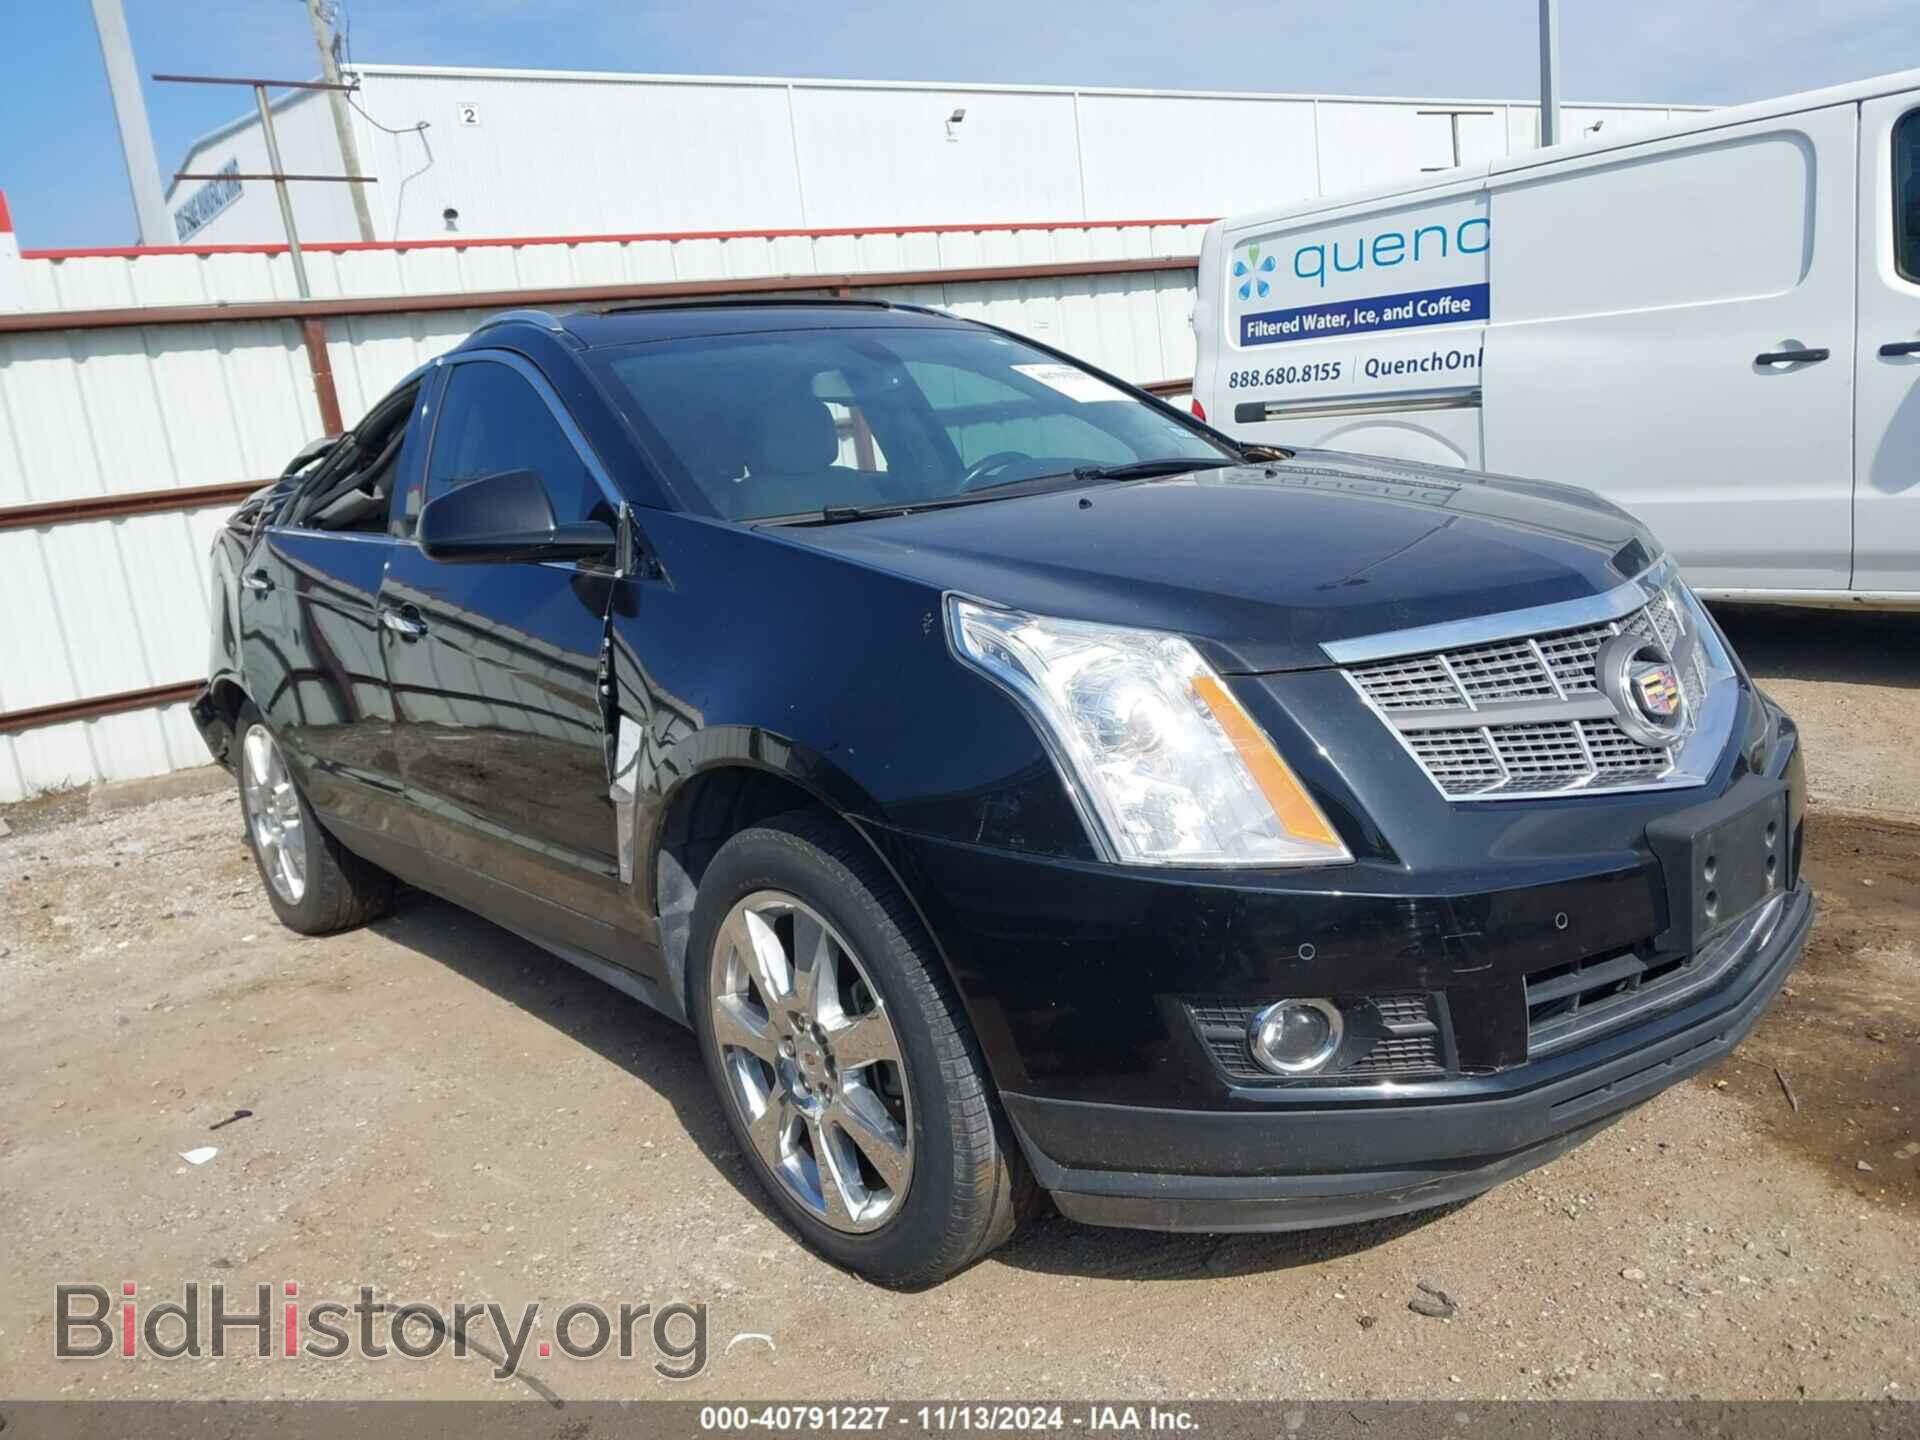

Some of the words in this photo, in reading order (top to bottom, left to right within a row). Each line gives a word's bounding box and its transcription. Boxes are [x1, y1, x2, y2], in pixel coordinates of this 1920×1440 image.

[464, 108, 476, 123] 2
[1246, 315, 1300, 338] Filtered
[1302, 313, 1351, 332] Water,
[1353, 308, 1380, 325] Ice,
[1382, 301, 1414, 322] and
[1416, 296, 1472, 317] Coffee
[1228, 361, 1342, 389] 888.680.8155
